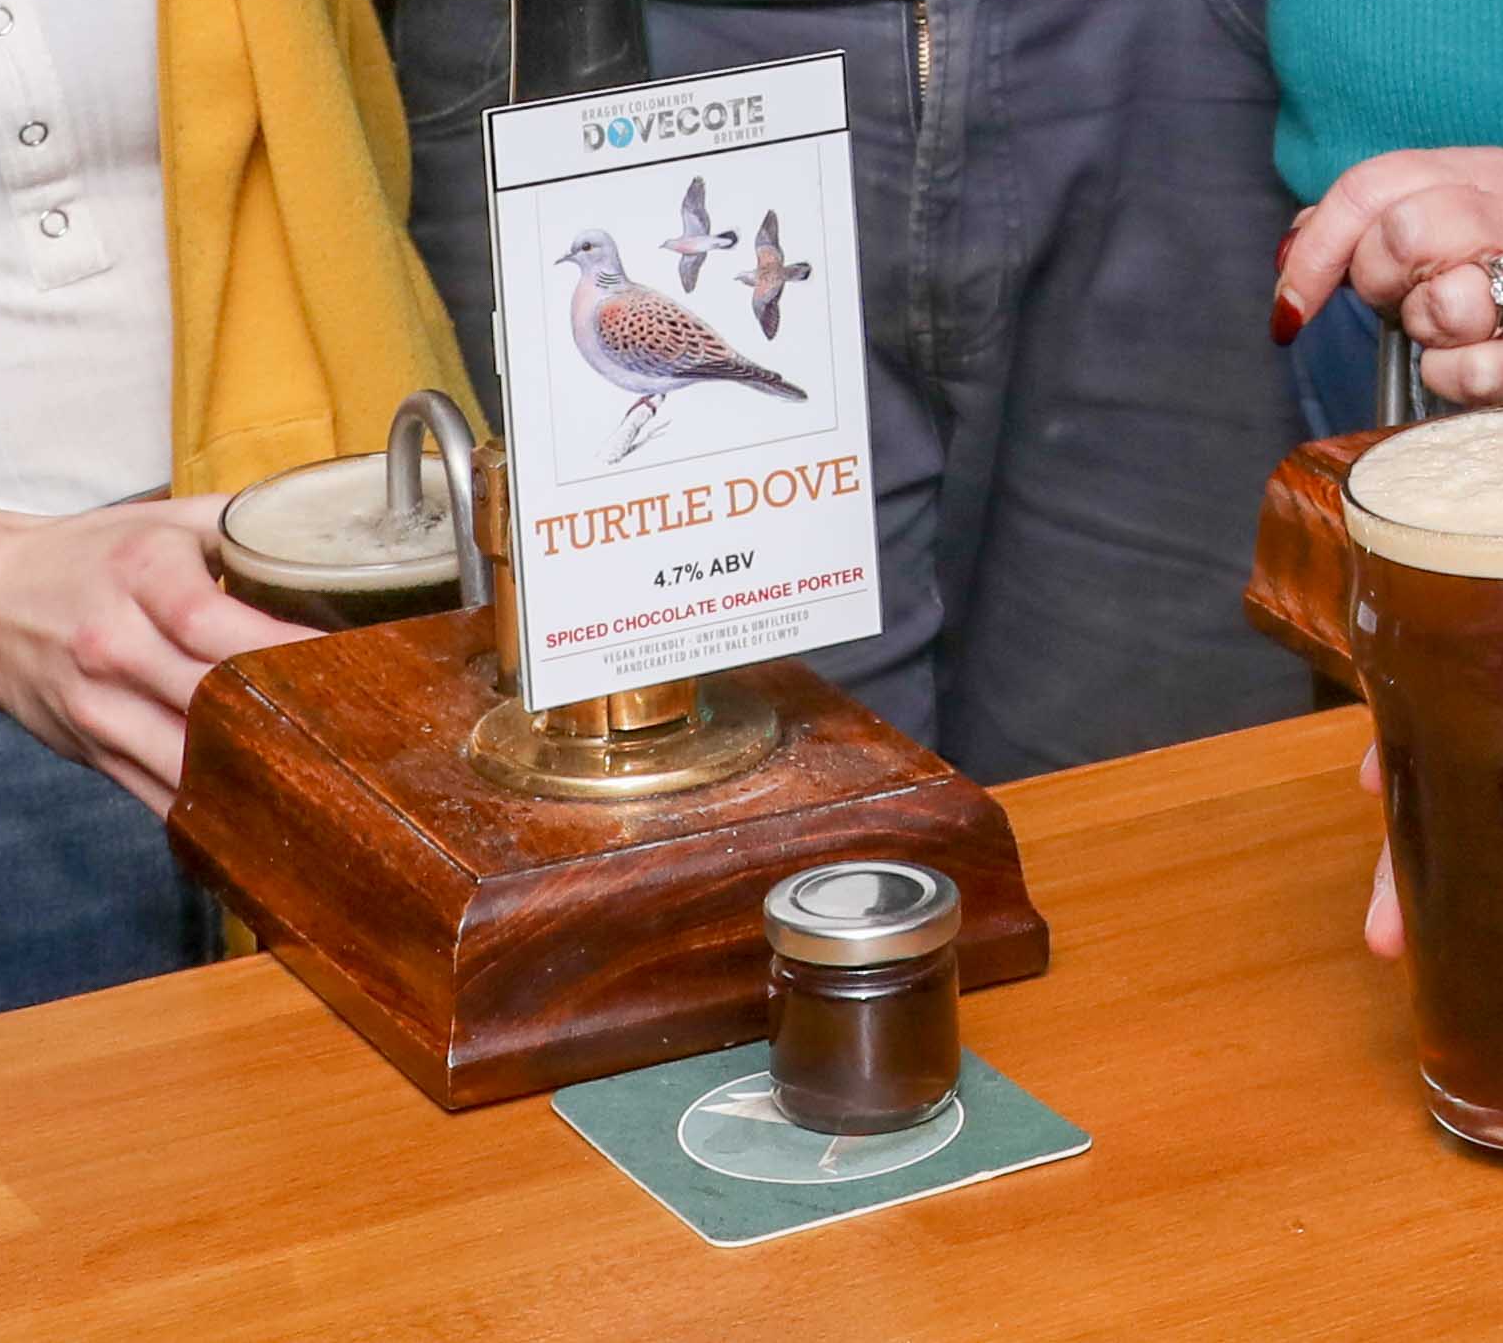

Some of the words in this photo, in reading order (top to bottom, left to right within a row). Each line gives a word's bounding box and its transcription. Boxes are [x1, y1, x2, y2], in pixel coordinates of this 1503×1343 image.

[582, 94, 765, 153] DOVECOTE
[535, 484, 715, 558] TURTLE
[725, 454, 861, 521] DOVE
[653, 562, 705, 589] 4.7%
[708, 550, 756, 578] ABV
[545, 621, 610, 650] SPICED
[612, 598, 719, 636] CHOCOLATE
[720, 581, 794, 611] ORANGE
[796, 566, 865, 595] PORTER
